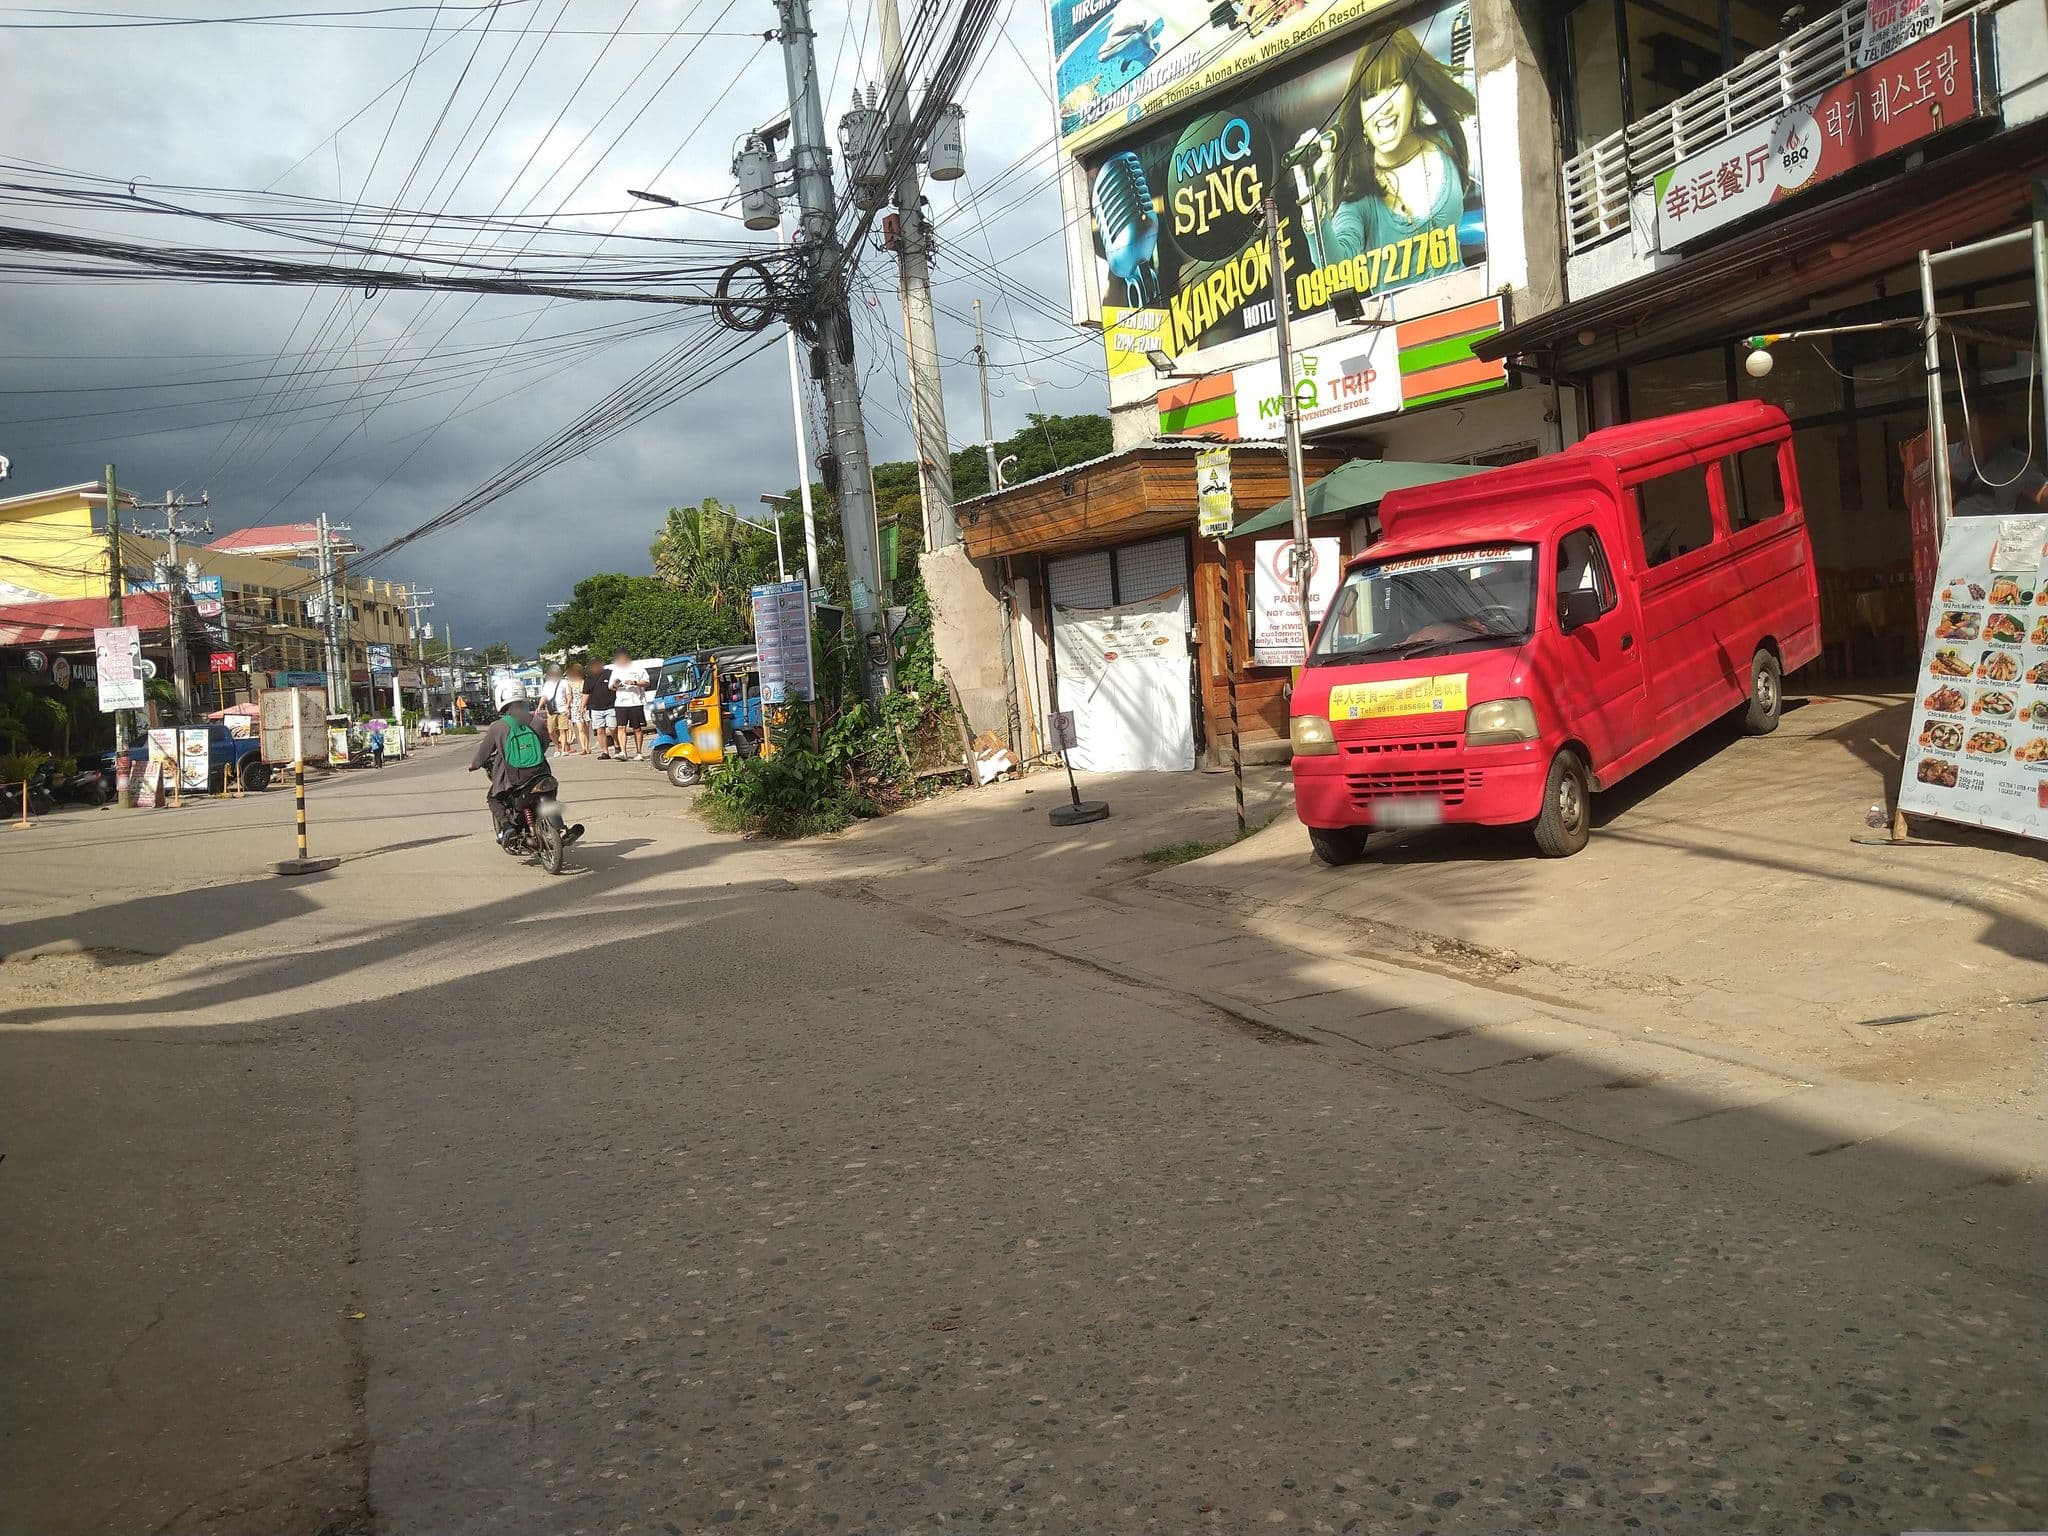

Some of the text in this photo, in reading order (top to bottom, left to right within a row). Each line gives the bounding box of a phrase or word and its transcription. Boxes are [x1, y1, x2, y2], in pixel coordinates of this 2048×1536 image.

[1205, 65, 1232, 85] Alona
[1260, 37, 1290, 60] White
[1292, 20, 1326, 45] Beach
[1328, 1, 1366, 28] Resort
[1825, 44, 1959, 148] 럭키 레스토랑
[1174, 117, 1252, 183] KWIQ
[1665, 143, 1771, 222] 幸运餐厅
[1782, 147, 1809, 168] BBQ
[1174, 163, 1264, 236] SING
[1170, 216, 1295, 353] KARAOKE
[1243, 223, 1459, 330] HOTLIE 09996727761
[1259, 369, 1377, 420] KWQ TRIP
[1343, 397, 1370, 411] STORE
[1384, 556, 1435, 574] SUPERIOR
[1435, 551, 1475, 566] MOTOR
[1479, 546, 1511, 559] CORP.
